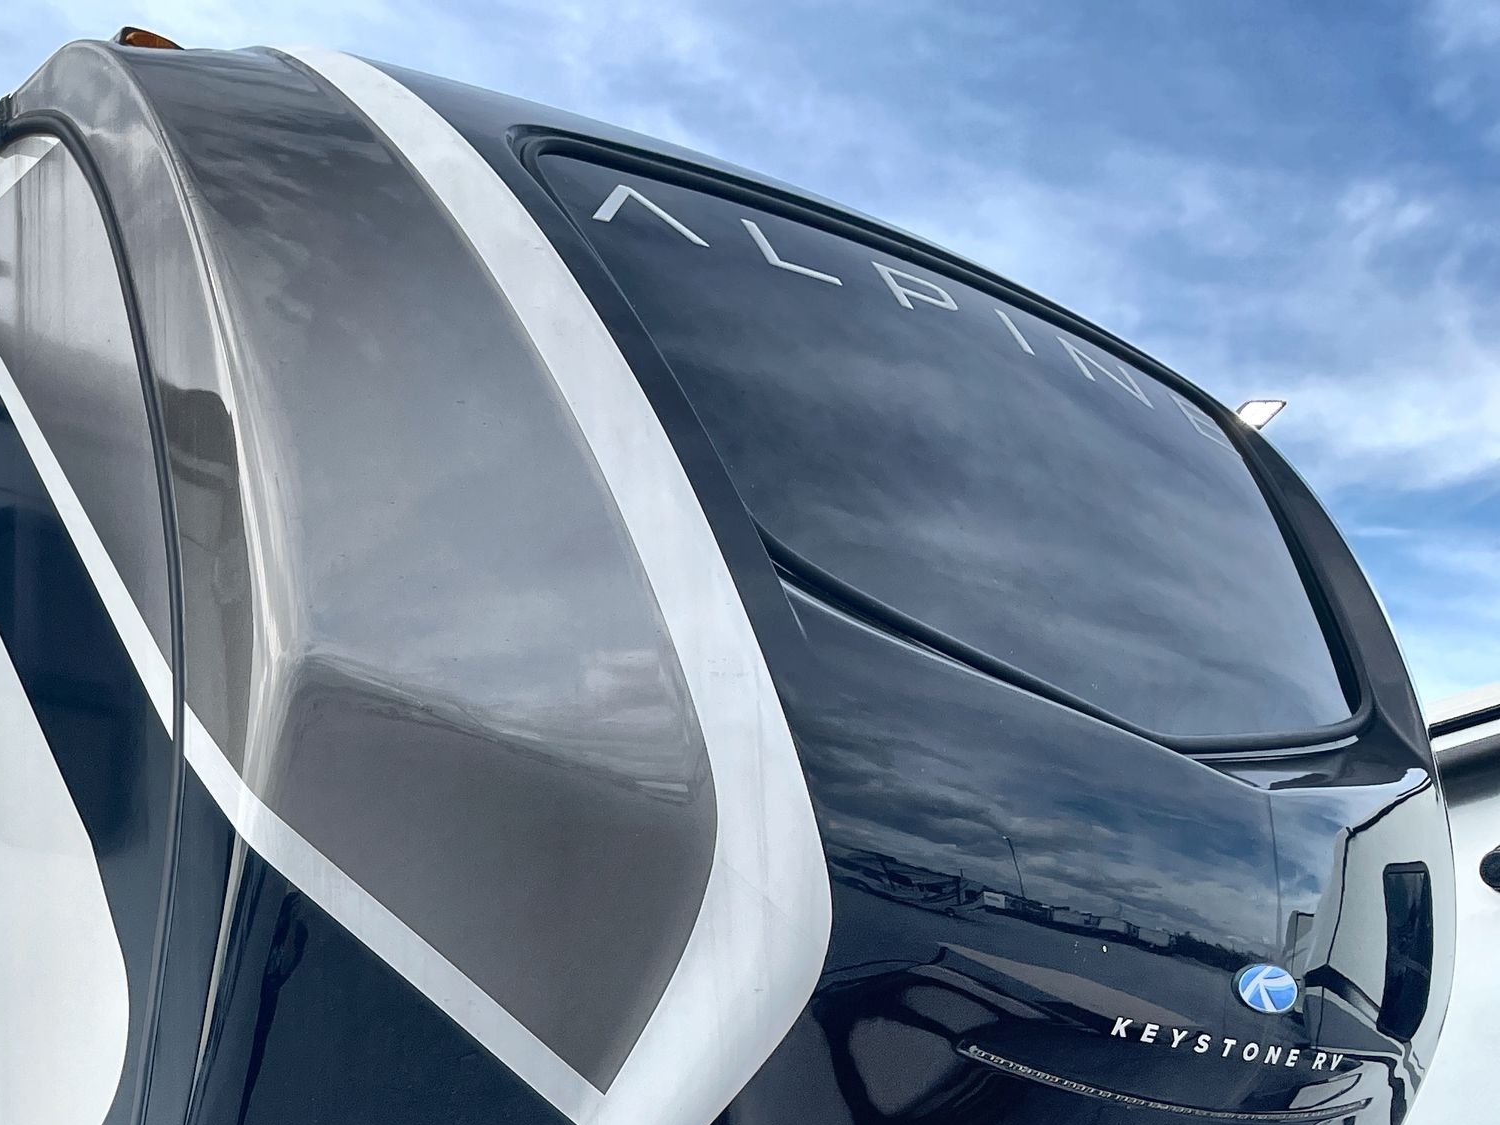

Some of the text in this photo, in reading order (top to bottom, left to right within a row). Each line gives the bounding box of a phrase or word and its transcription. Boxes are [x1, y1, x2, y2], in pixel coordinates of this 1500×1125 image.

[591, 183, 1244, 460] ALPINE
[1110, 1016, 1344, 1072] KEYSTONE RV
